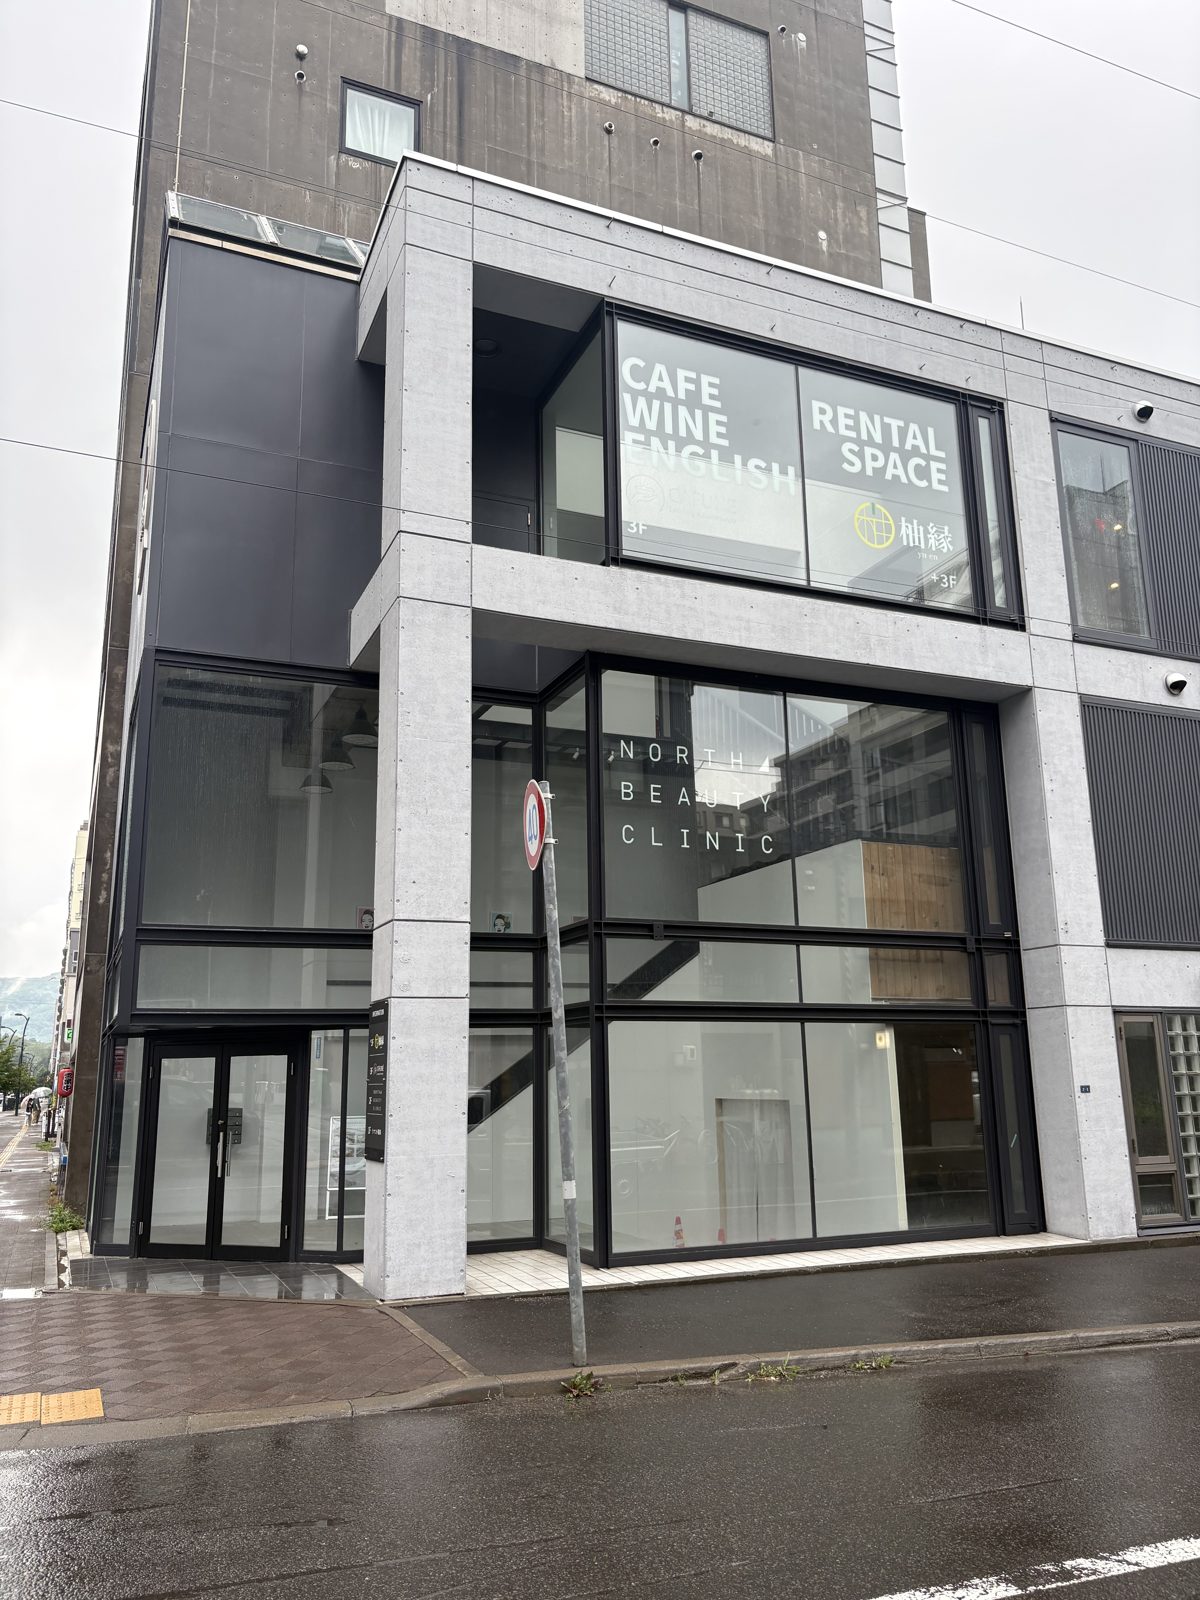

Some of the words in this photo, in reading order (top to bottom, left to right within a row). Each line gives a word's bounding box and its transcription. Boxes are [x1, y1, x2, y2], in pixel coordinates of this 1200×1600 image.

[621, 356, 722, 409] CAFE
[623, 392, 730, 447] WINE
[811, 399, 947, 459] RENTAL
[623, 430, 797, 496] ENGLISH
[840, 441, 949, 493] SPACE
[627, 521, 648, 536] 3F
[898, 516, 954, 553] 柚縁
[620, 739, 744, 771] NORTH
[621, 781, 772, 813] BEAUTY
[528, 803, 539, 844] 40
[622, 824, 773, 854] CLINIC
